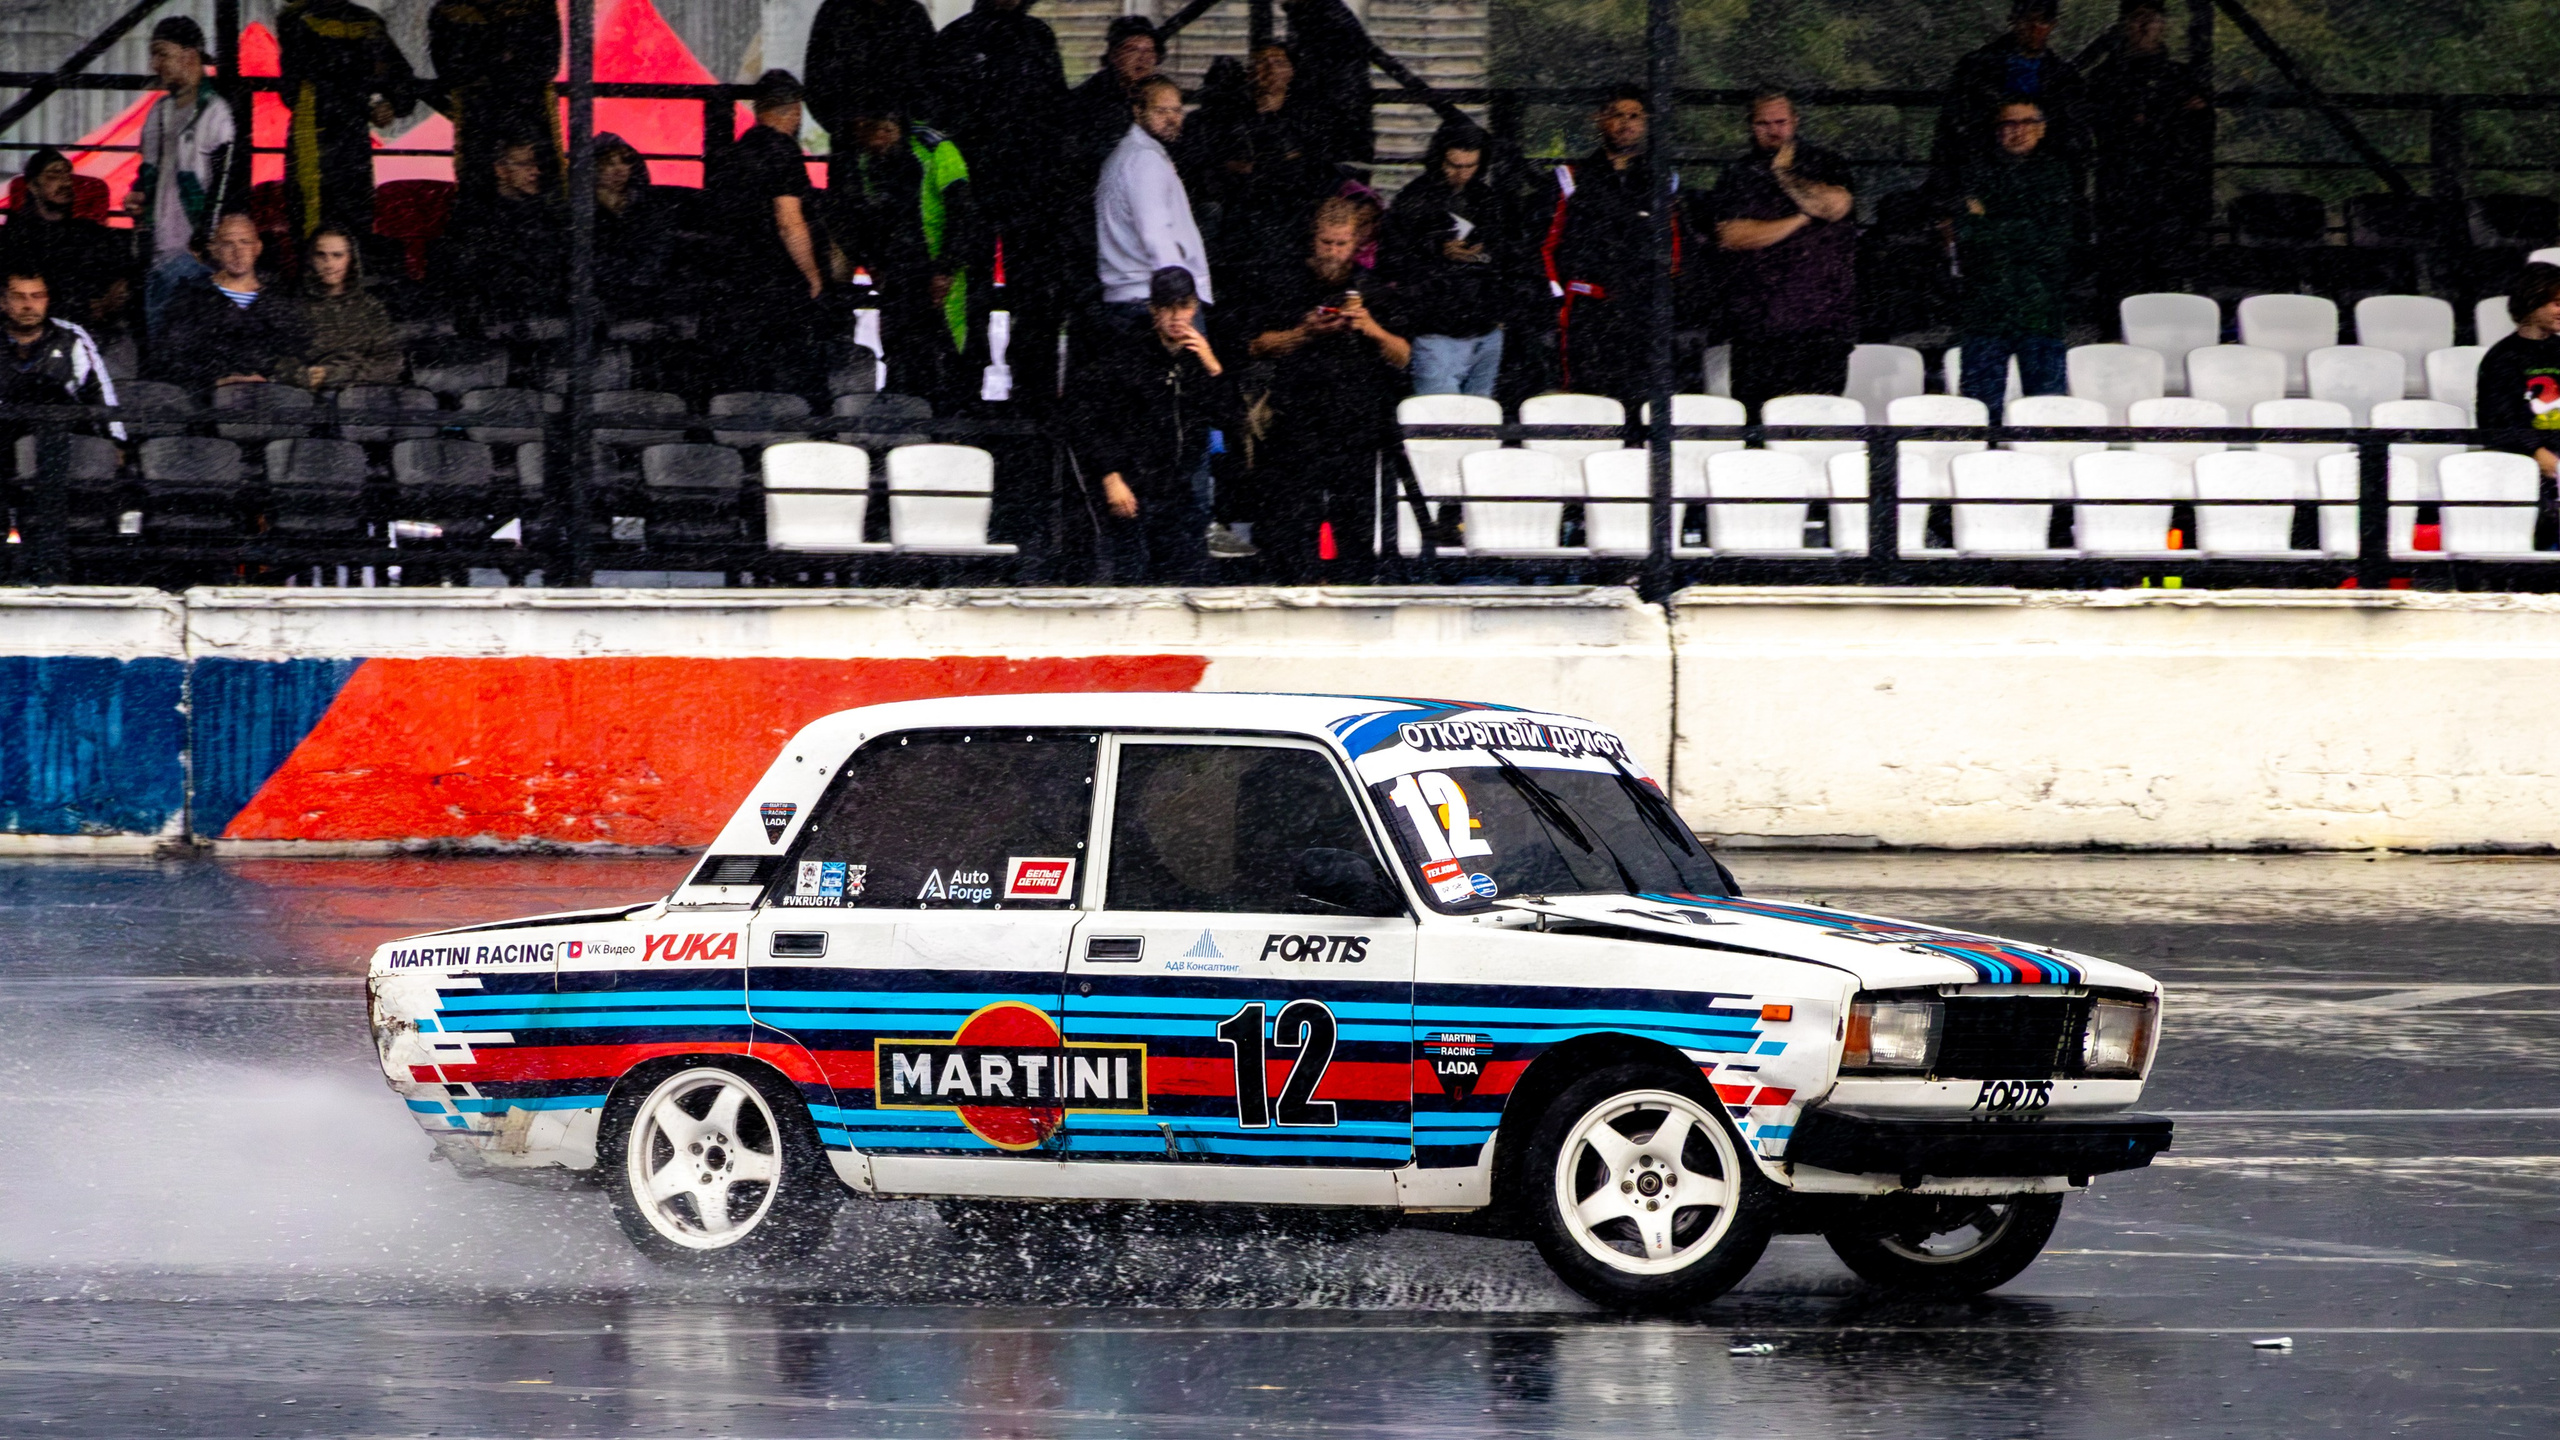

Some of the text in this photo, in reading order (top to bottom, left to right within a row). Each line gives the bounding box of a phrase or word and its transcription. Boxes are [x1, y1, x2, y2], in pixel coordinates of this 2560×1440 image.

[1399, 717, 1630, 763] ОТКРЫТЫЙ ДРИФТ
[765, 818, 787, 826] LADA
[1390, 771, 1493, 861] 12
[950, 870, 989, 884] Auto
[1026, 868, 1062, 878] БЕЛЫЕ
[1017, 877, 1059, 887] ДЕТАЛИ
[783, 896, 841, 906] #VKRUG174
[949, 885, 992, 903] Forge
[587, 944, 635, 955] VK Видео
[642, 932, 739, 962] YUKA
[1259, 934, 1371, 963] FORTIS
[390, 943, 554, 968] MARTINI RACING
[1165, 960, 1239, 972] АДВ Консалтинг
[1441, 1033, 1476, 1042] MARTINI
[1441, 1047, 1476, 1056] RACING
[1216, 999, 1338, 1128] 12
[1438, 1061, 1478, 1075] LADA
[892, 1052, 1128, 1099] MARTINI
[1968, 1080, 2055, 1111] FORTIS
